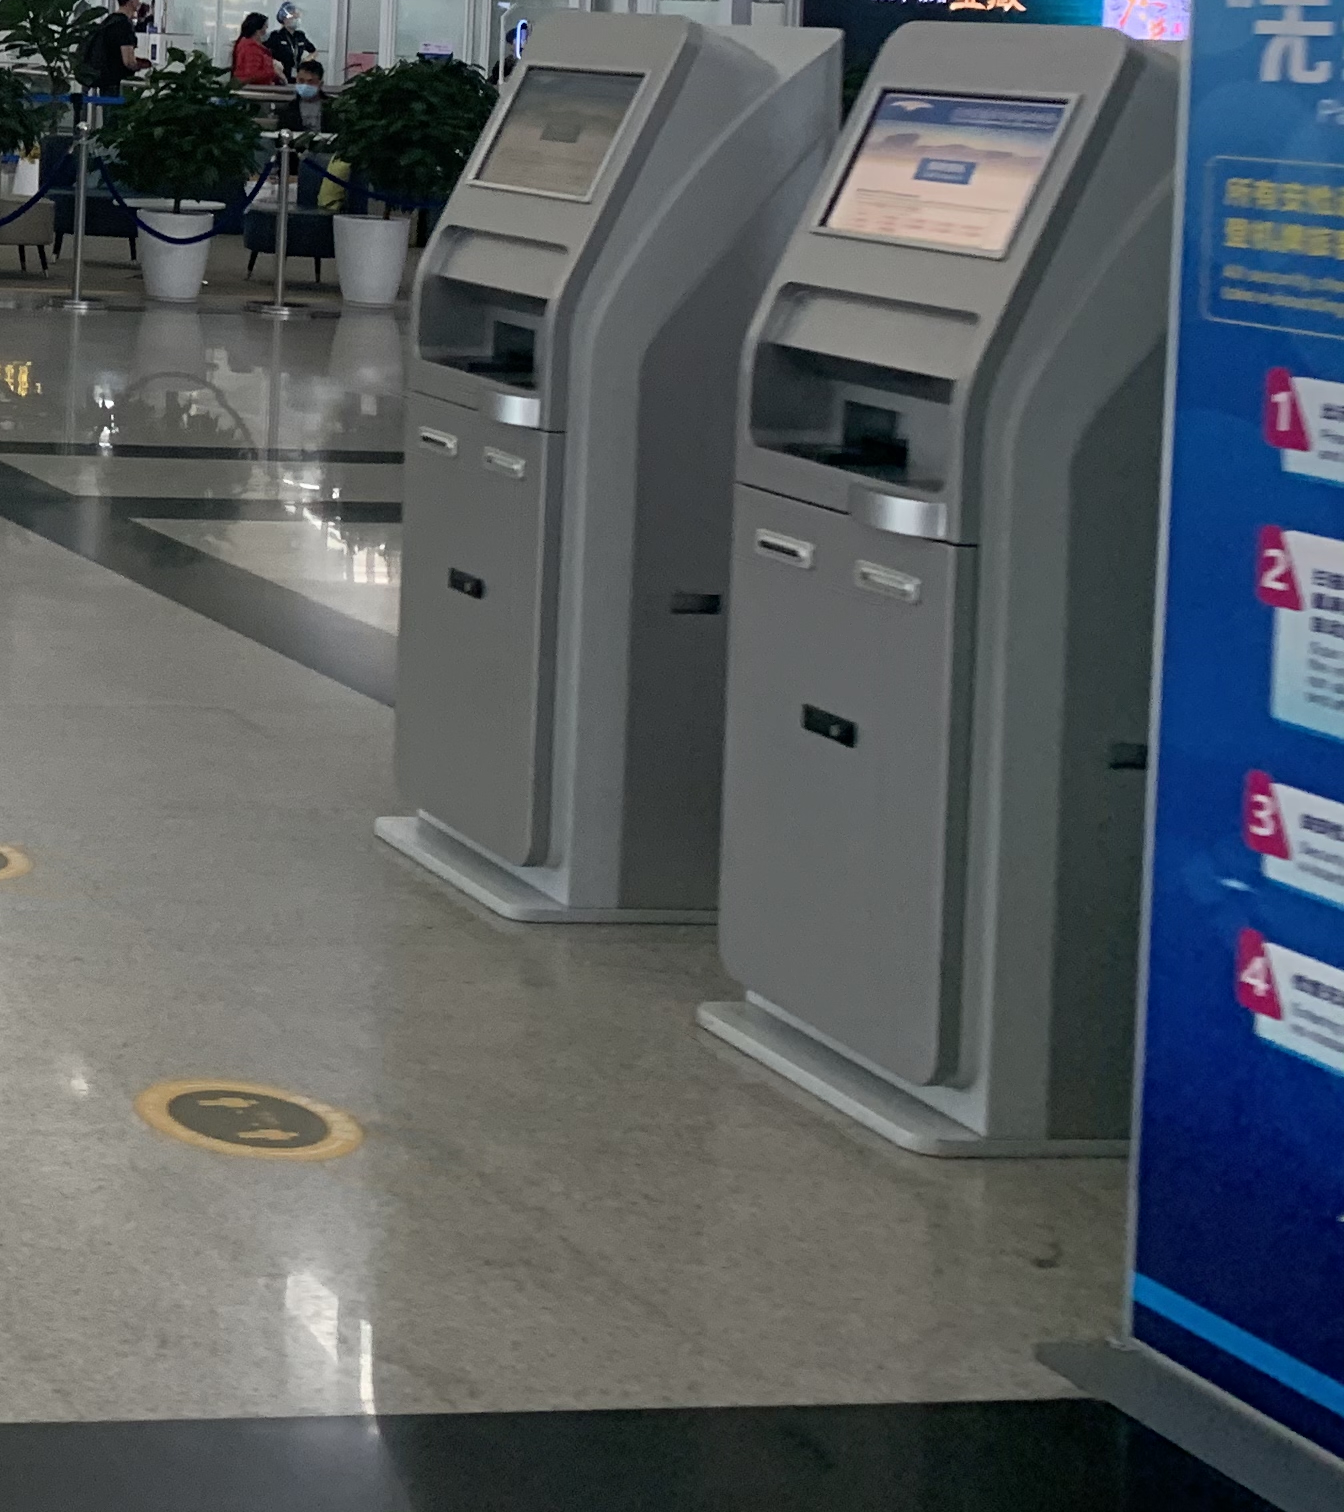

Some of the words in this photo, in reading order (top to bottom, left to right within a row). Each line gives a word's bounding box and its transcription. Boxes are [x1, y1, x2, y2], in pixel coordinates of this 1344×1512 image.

[1271, 391, 1291, 431] 1
[1262, 549, 1288, 591] 2
[1249, 793, 1275, 837] 3
[1241, 956, 1269, 997] 4
